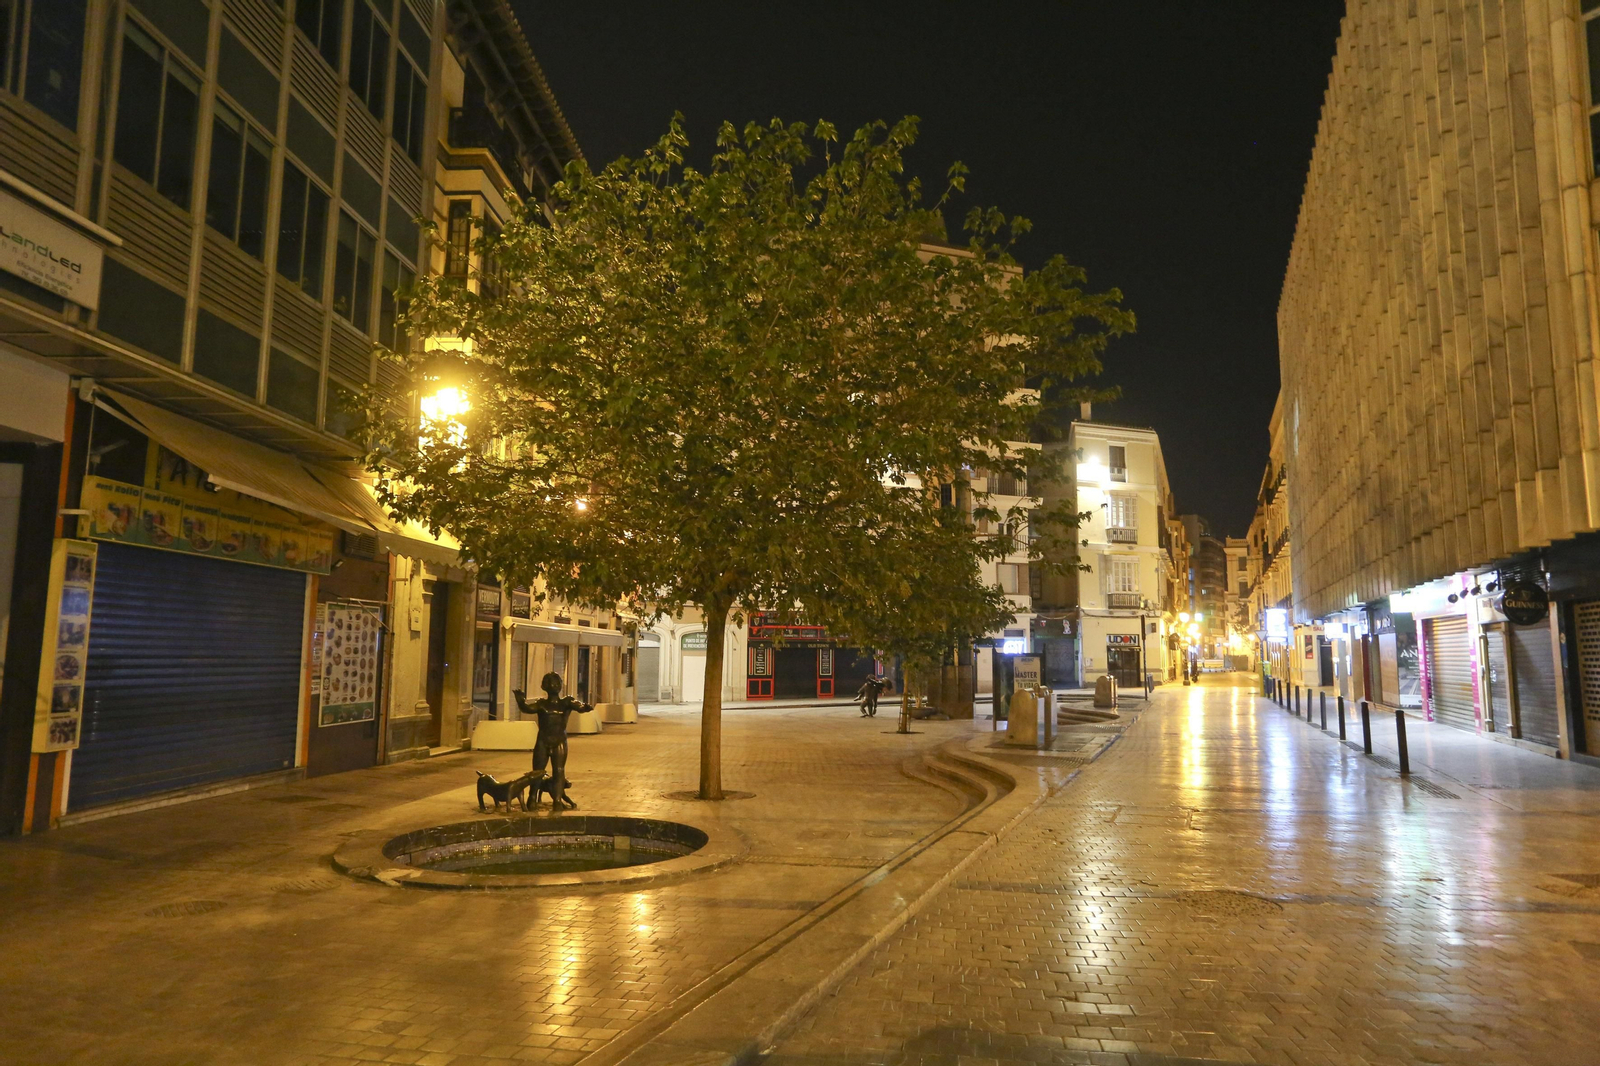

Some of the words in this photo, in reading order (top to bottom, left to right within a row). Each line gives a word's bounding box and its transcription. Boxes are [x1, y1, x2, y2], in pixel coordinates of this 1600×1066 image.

[1505, 599, 1545, 609] GUINNESS
[1108, 635, 1137, 644] UDON
[1015, 671, 1038, 679] MASTER
